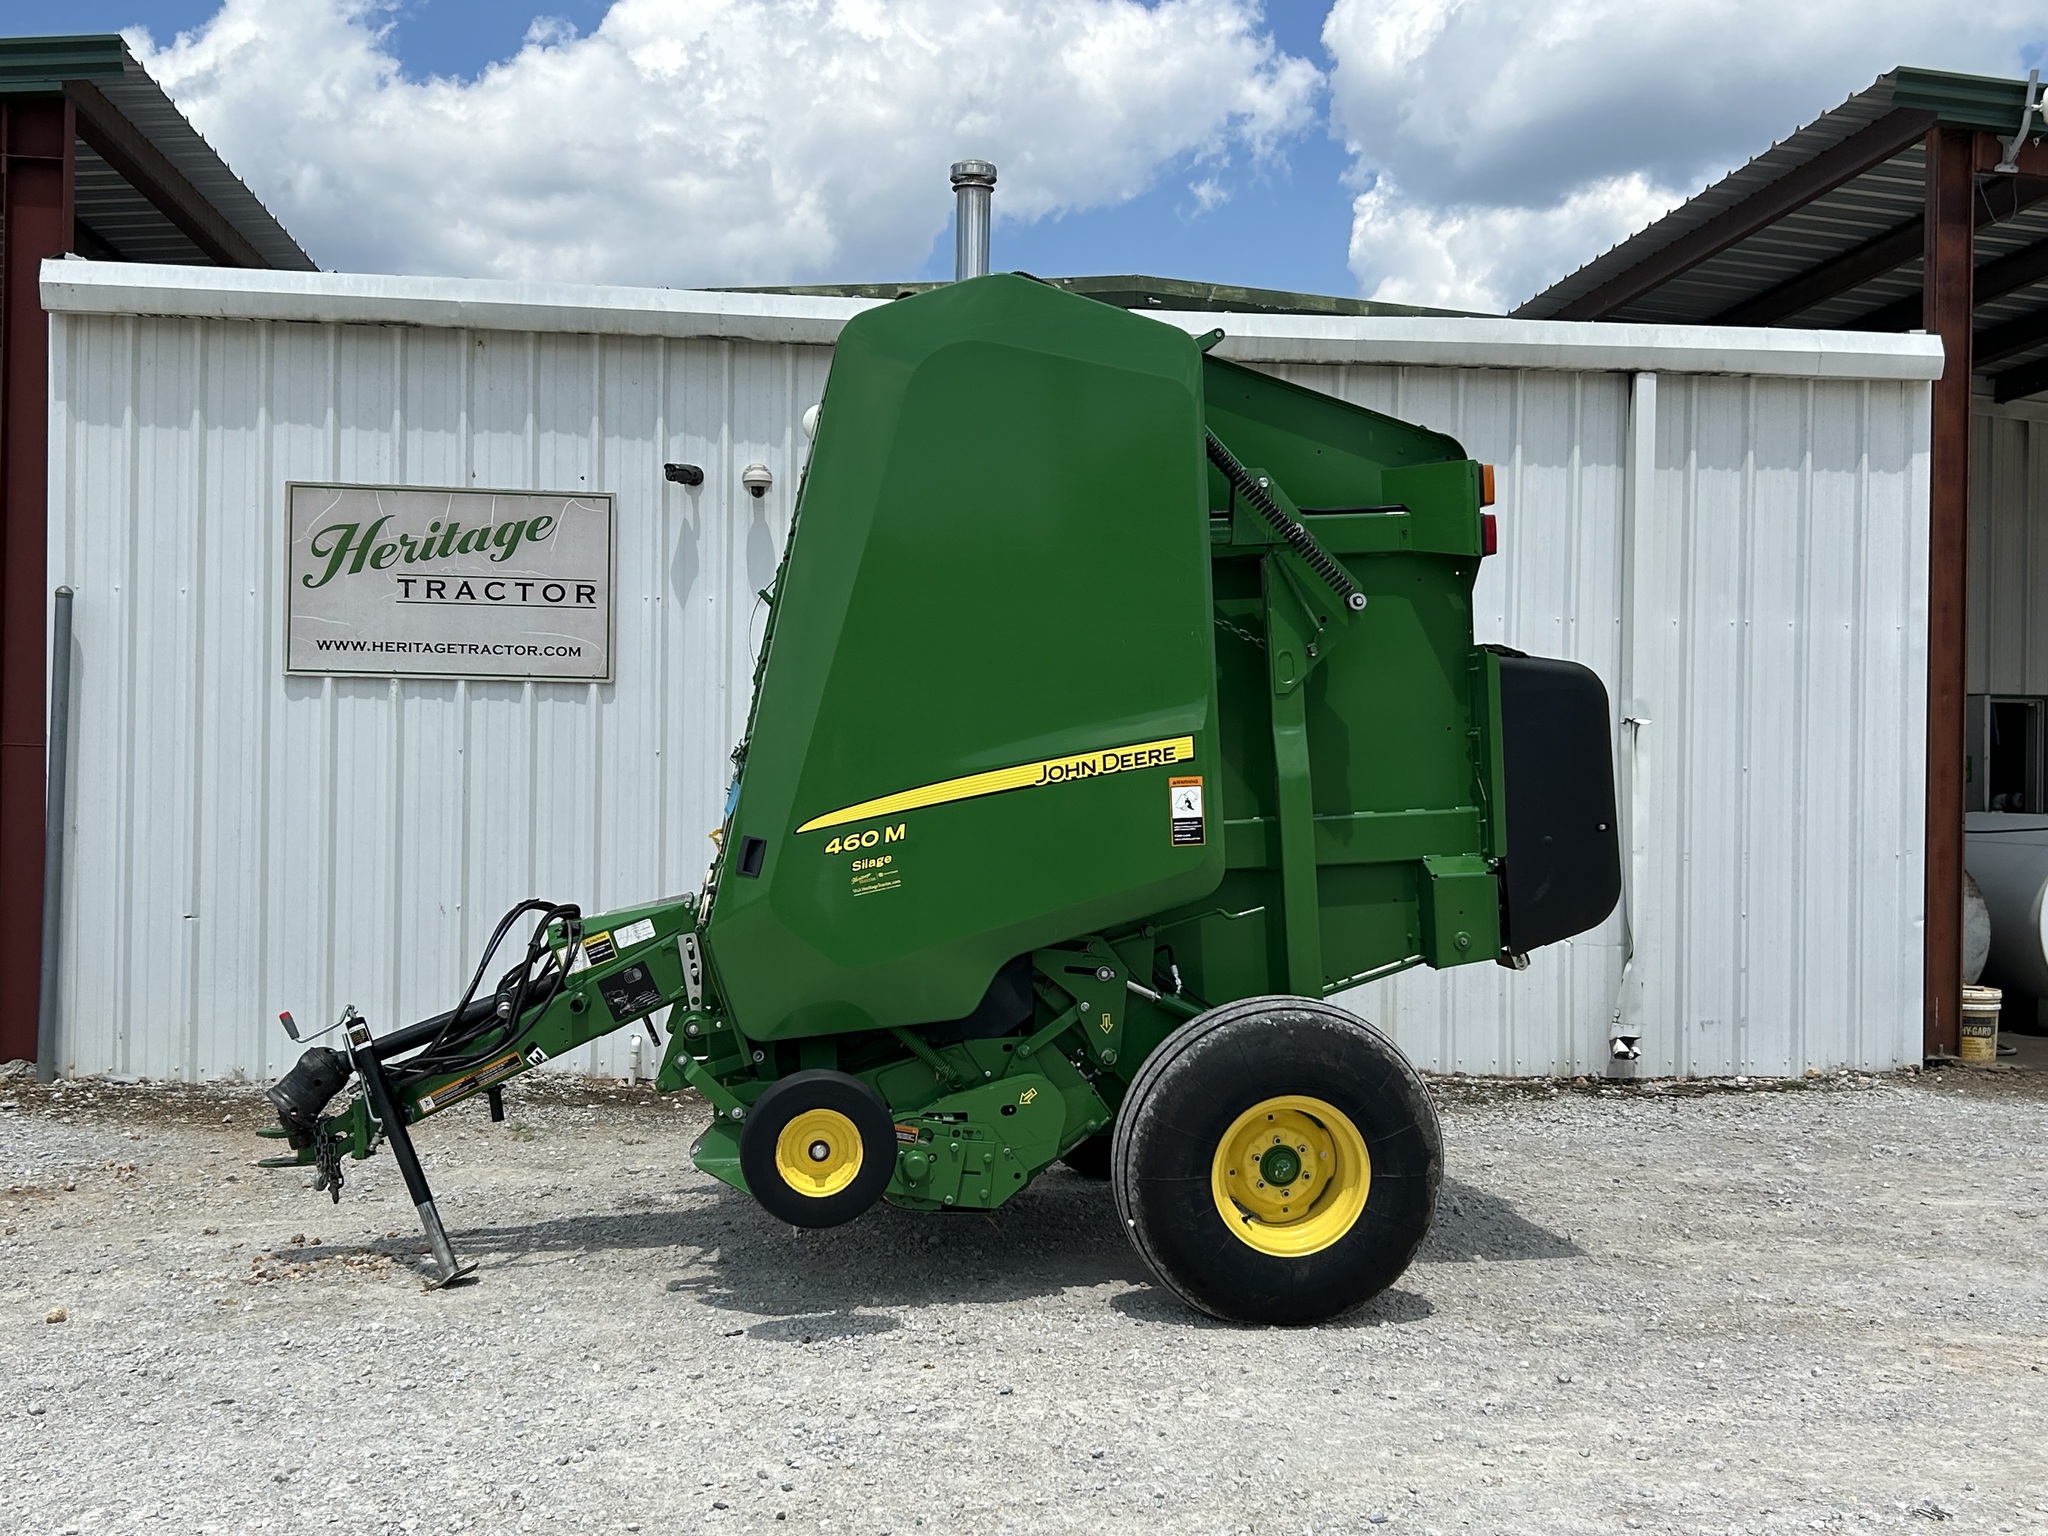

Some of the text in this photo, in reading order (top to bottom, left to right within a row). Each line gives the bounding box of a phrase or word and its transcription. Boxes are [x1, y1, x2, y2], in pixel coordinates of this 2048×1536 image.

[302, 515, 558, 588] Heritage
[397, 578, 597, 604] TRACTOR
[316, 639, 582, 657] WWW.HERITAGETRACTOR.COM
[1035, 746, 1176, 784] JOHN DEERE
[824, 822, 907, 855] 460 M
[851, 855, 893, 872] Silage
